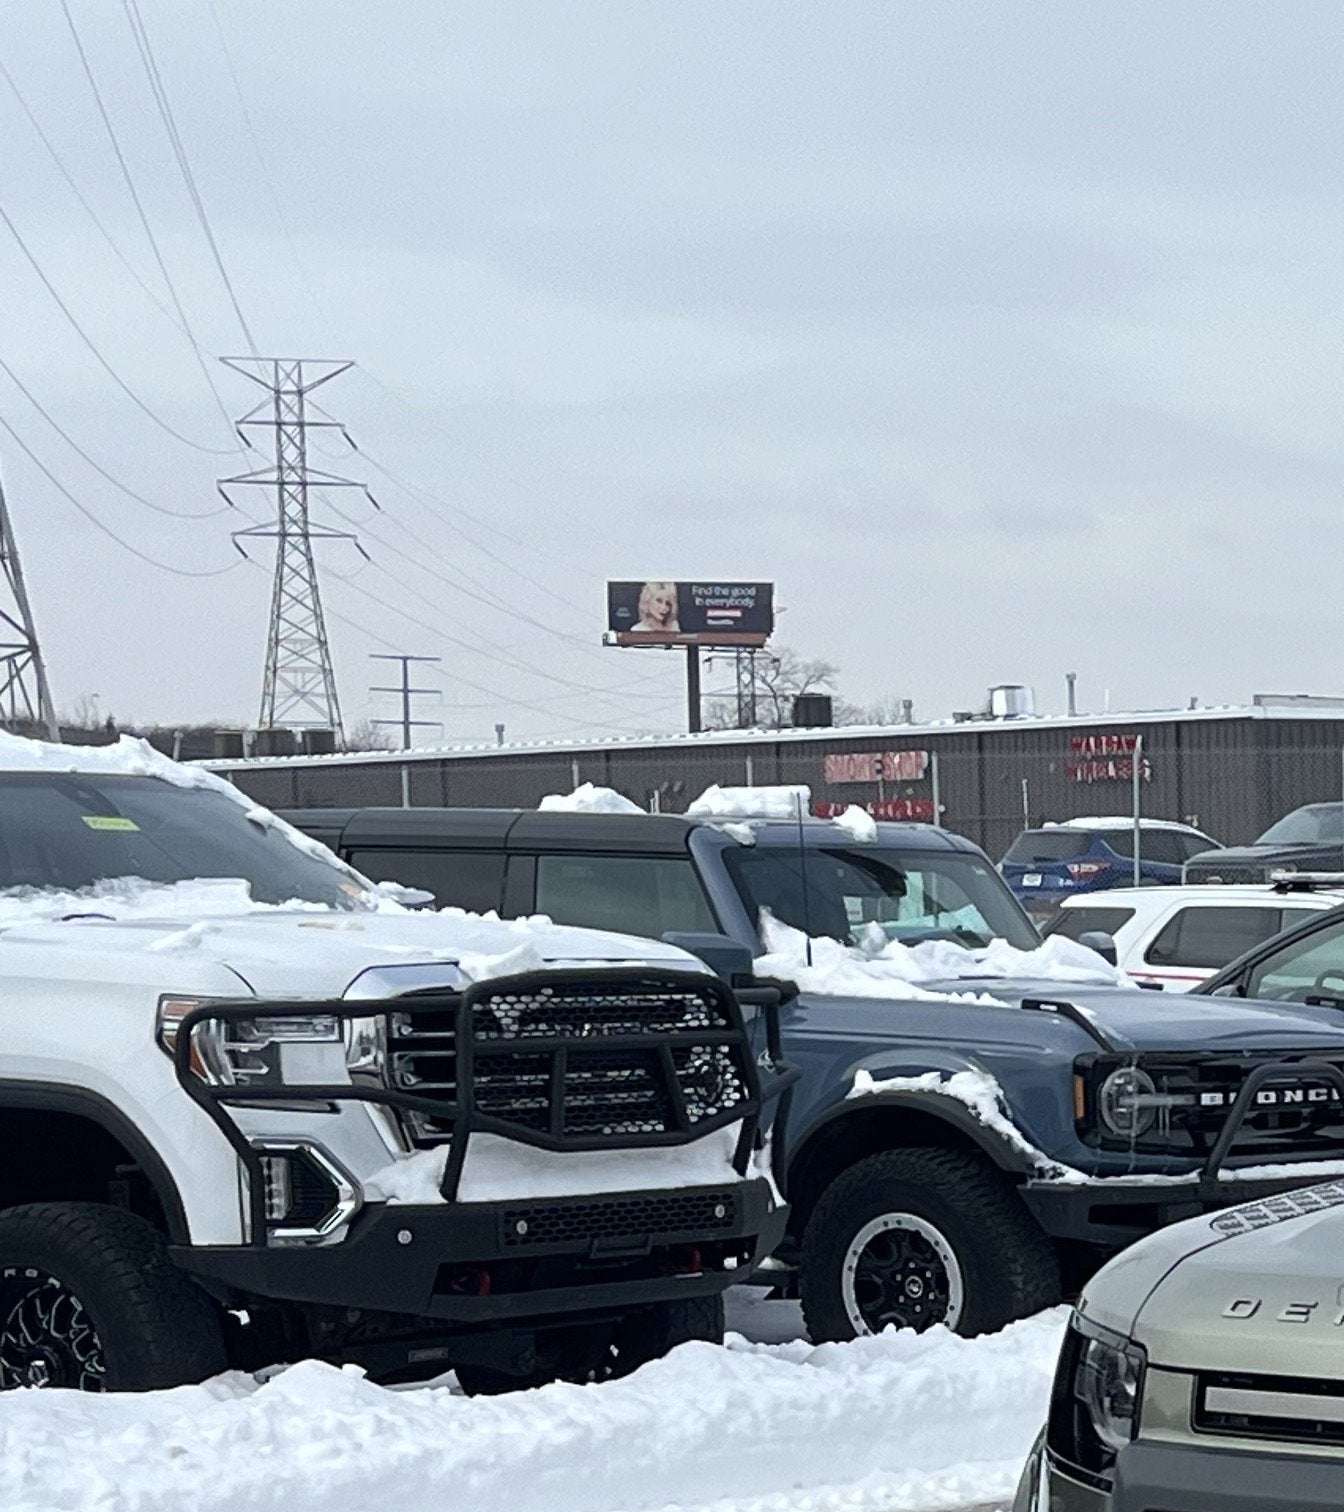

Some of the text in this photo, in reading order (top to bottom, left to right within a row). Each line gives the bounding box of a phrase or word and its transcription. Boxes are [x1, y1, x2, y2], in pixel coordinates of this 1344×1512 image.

[691, 585, 756, 598] Find the good
[823, 750, 928, 784] SMOKE SHOP
[1201, 1087, 1340, 1106] BONC
